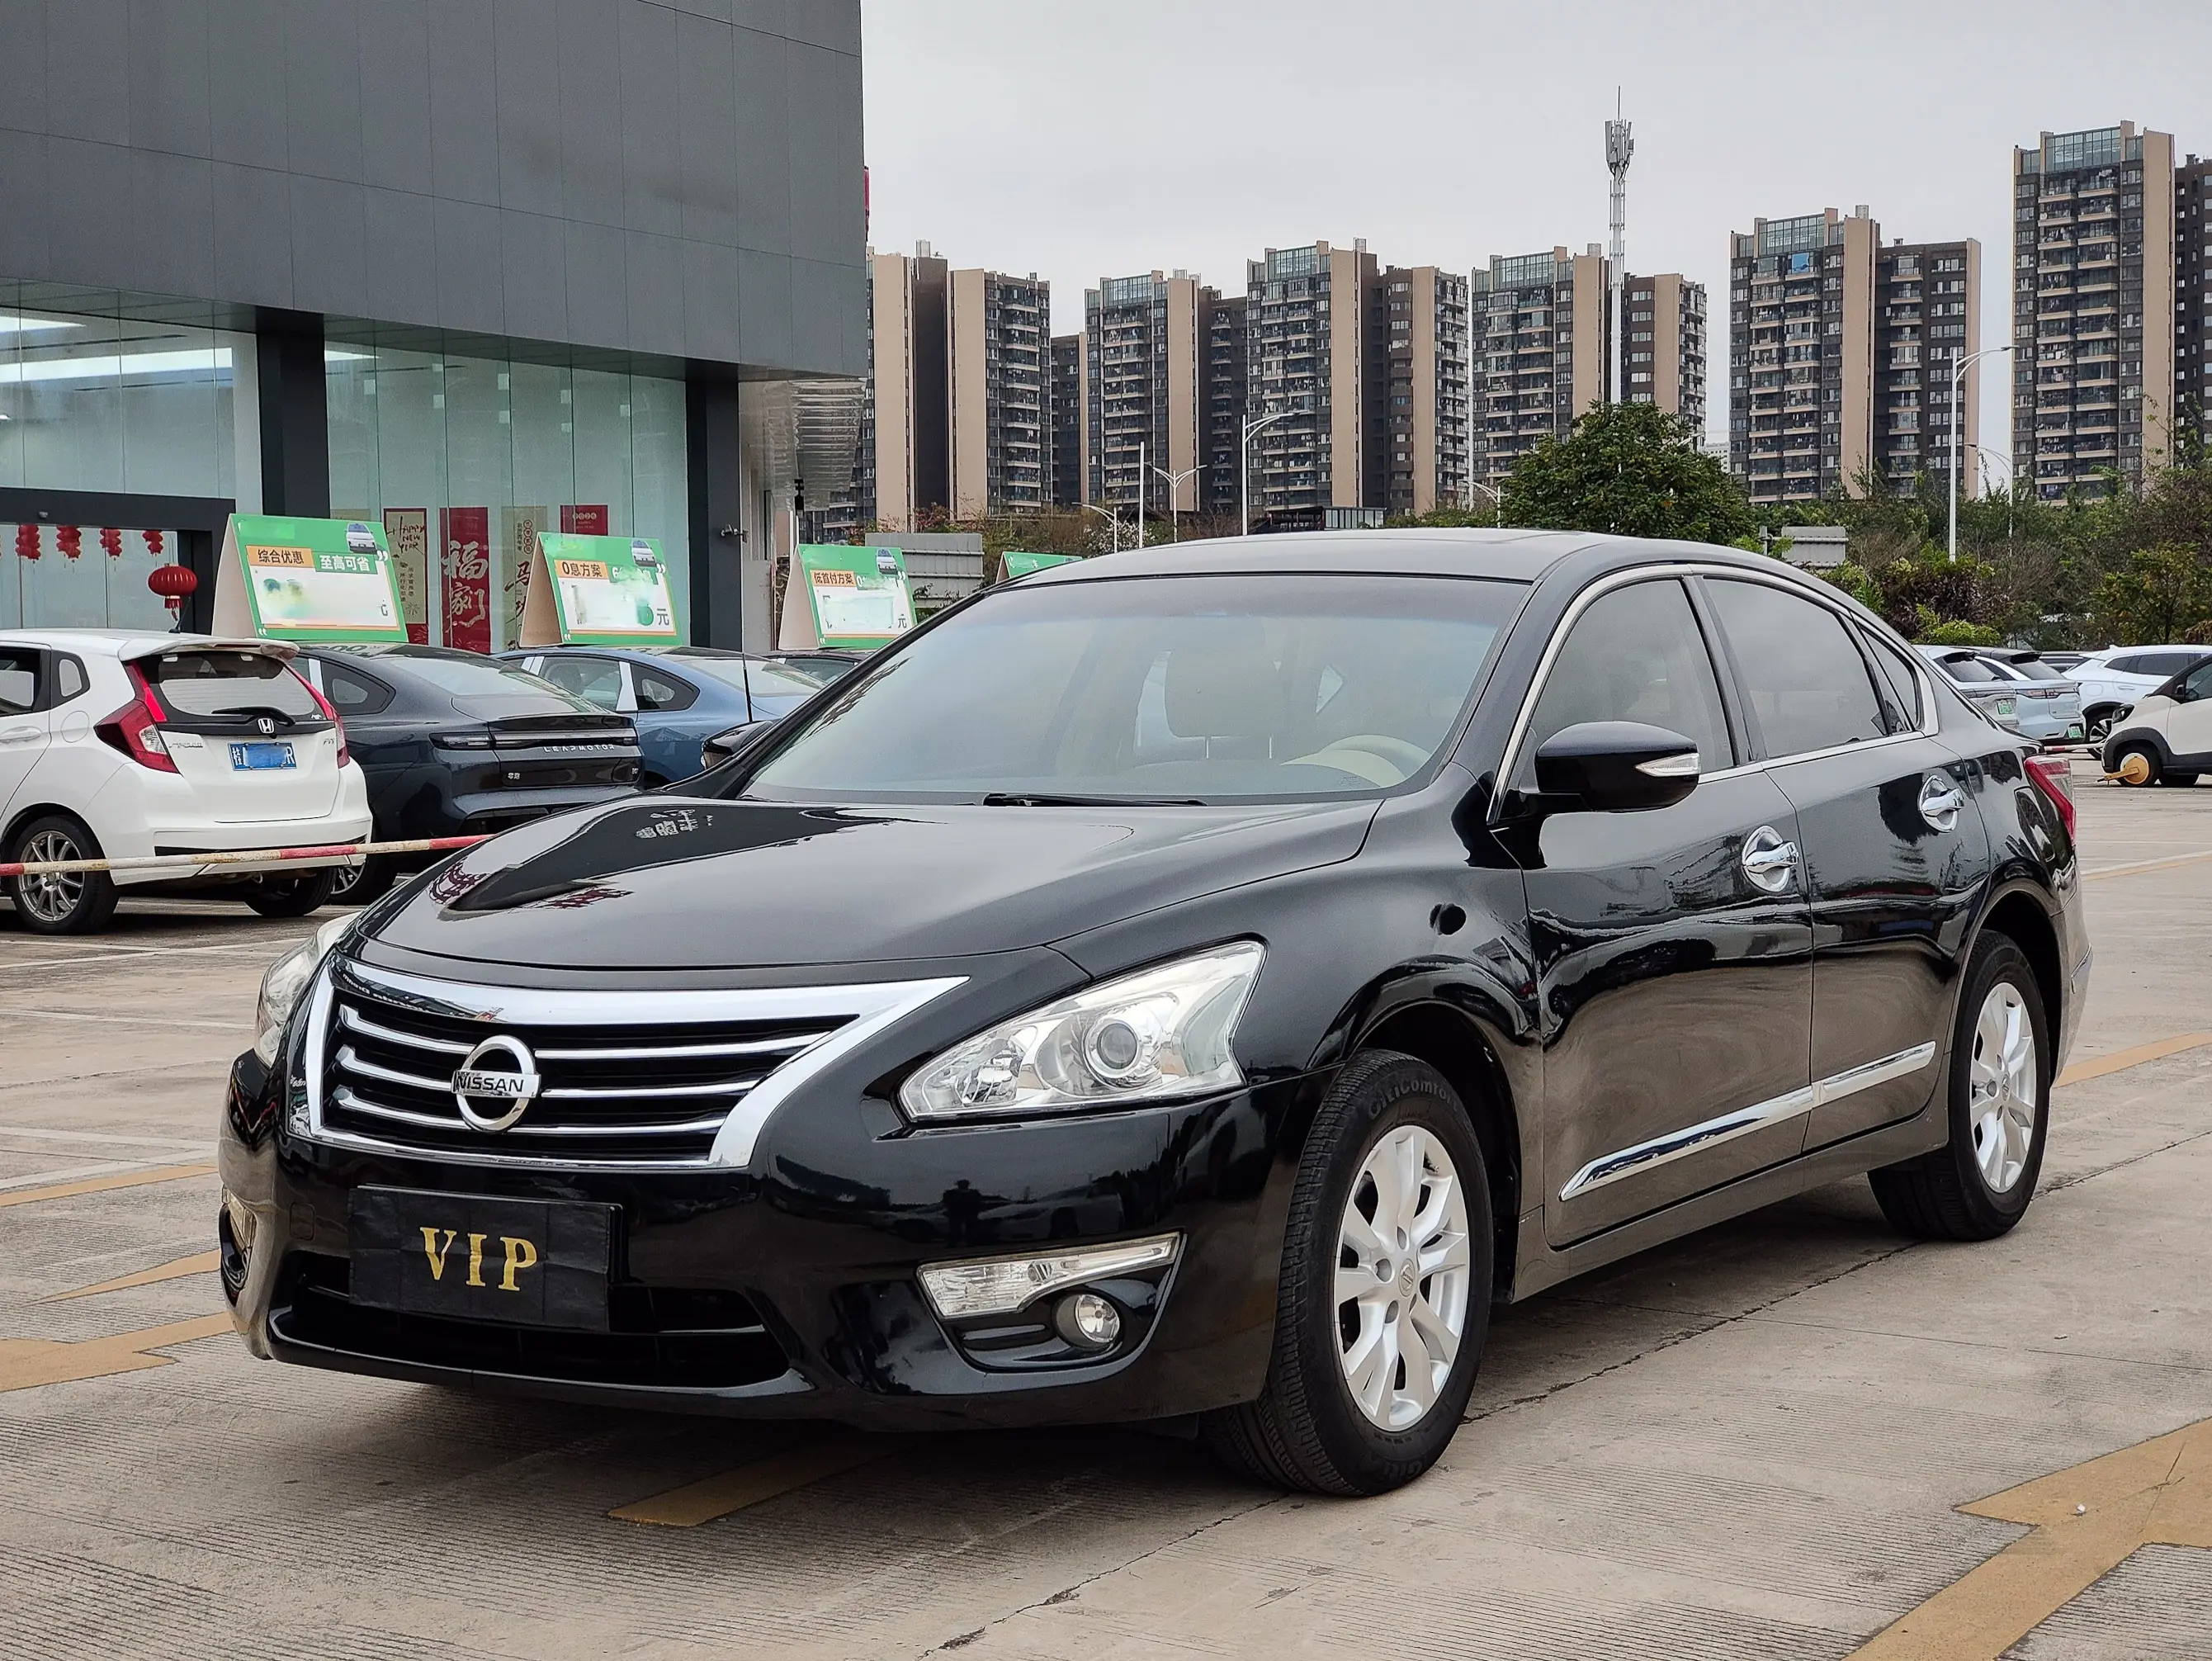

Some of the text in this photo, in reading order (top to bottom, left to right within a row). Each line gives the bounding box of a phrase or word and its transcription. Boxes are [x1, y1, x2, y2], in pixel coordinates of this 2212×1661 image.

[397, 542, 424, 555] YEAR
[258, 549, 305, 564] 综合优惠
[319, 555, 371, 571] 至高可省
[561, 561, 603, 578] 0息方案
[813, 573, 854, 584] 低首付方案
[543, 744, 615, 753] LEAPMOTOR
[456, 1076, 524, 1092] NISSAN
[419, 1227, 537, 1291] VIP
